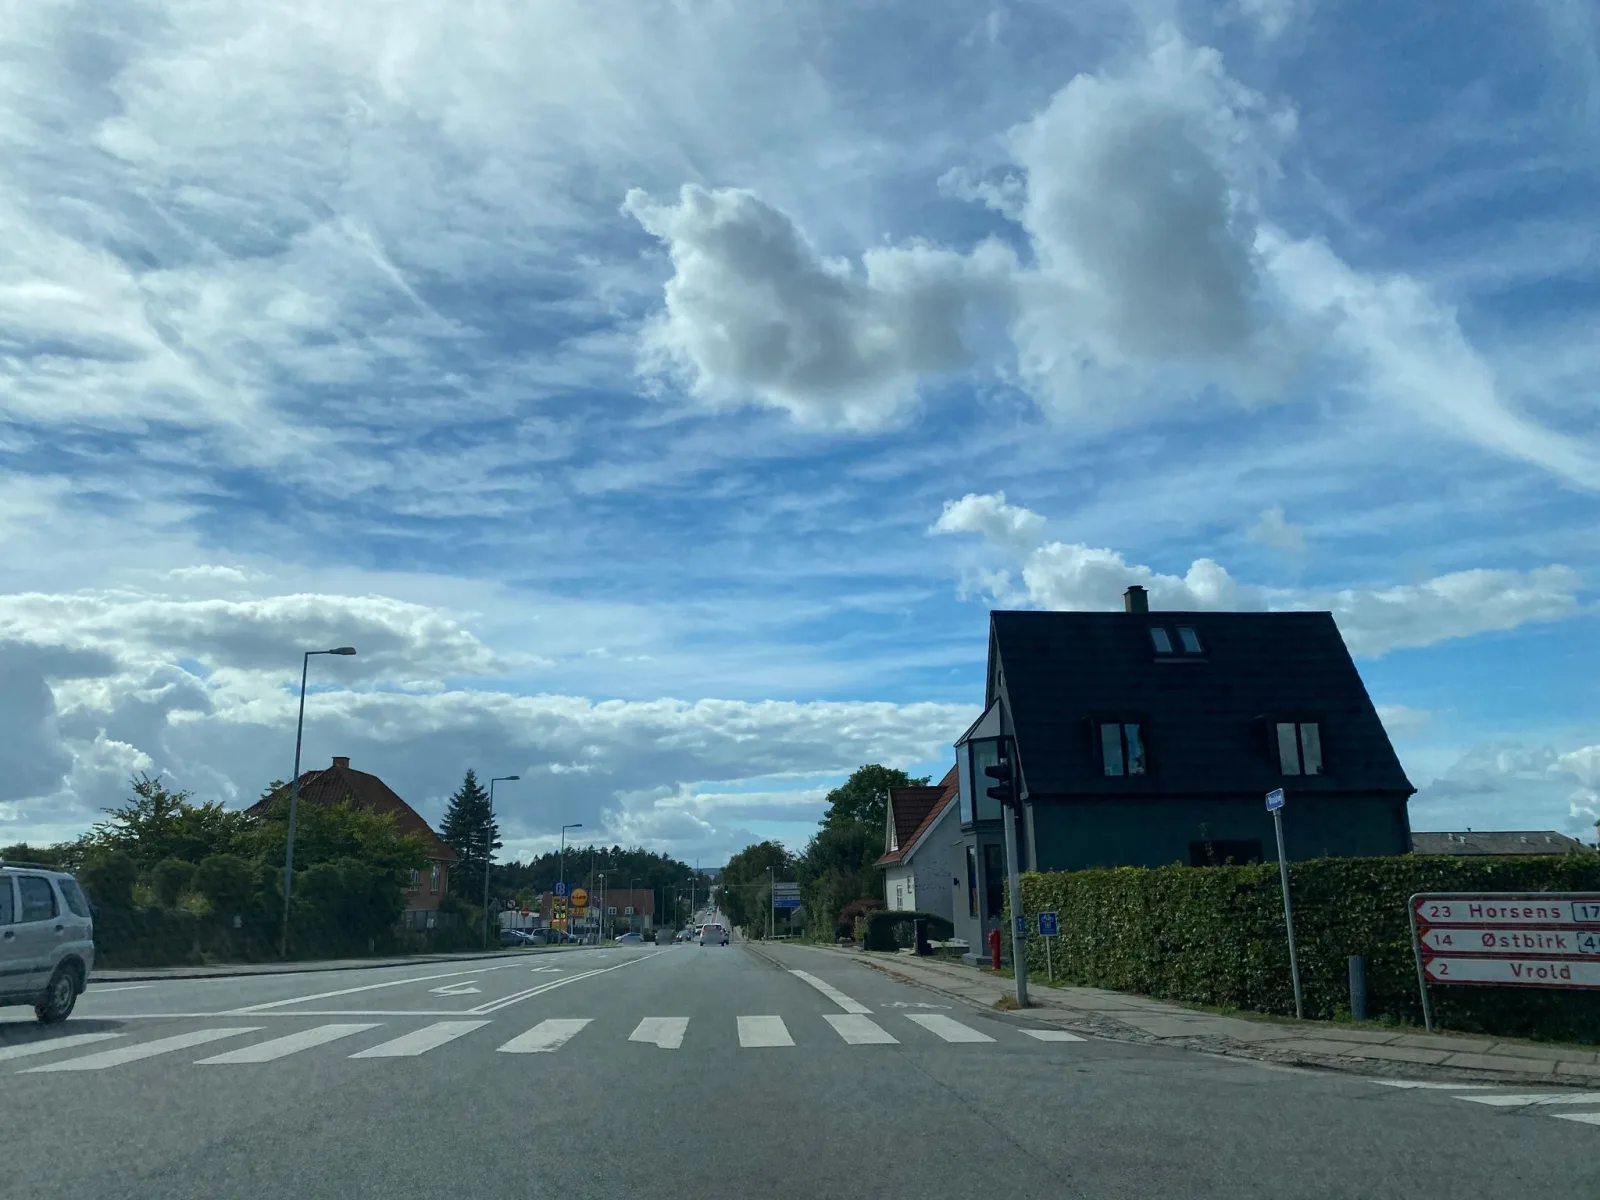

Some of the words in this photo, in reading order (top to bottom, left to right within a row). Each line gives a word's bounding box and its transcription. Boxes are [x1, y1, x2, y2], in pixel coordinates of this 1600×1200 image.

[1430, 906, 1452, 918] 23
[1469, 904, 1561, 919] Horsens
[1433, 934, 1453, 946] 14
[1482, 932, 1567, 949] Østbirk
[1584, 936, 1600, 950] 4
[1439, 963, 1449, 975] 2
[1510, 963, 1572, 980] Vrold
